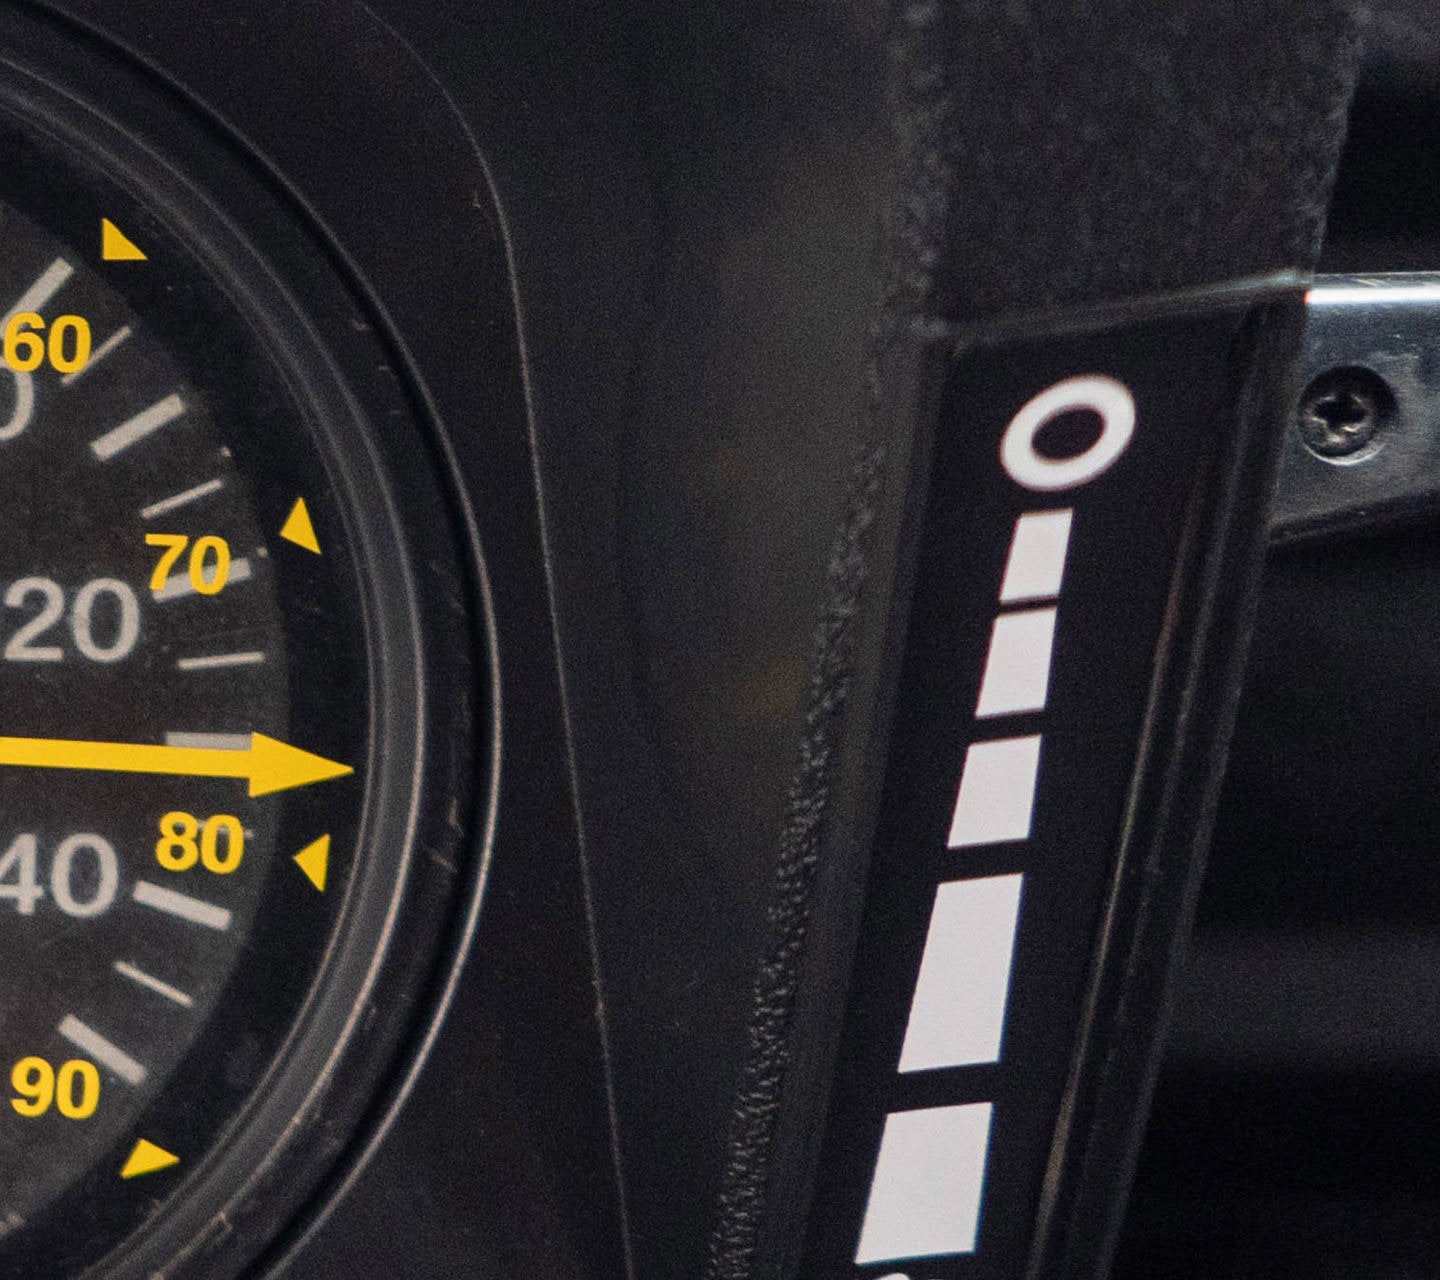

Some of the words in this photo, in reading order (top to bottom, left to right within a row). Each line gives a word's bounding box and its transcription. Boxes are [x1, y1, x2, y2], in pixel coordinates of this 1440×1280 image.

[3, 312, 92, 374] 60
[145, 533, 231, 595] 70
[156, 811, 245, 874] 80
[10, 1056, 100, 1119] 90
